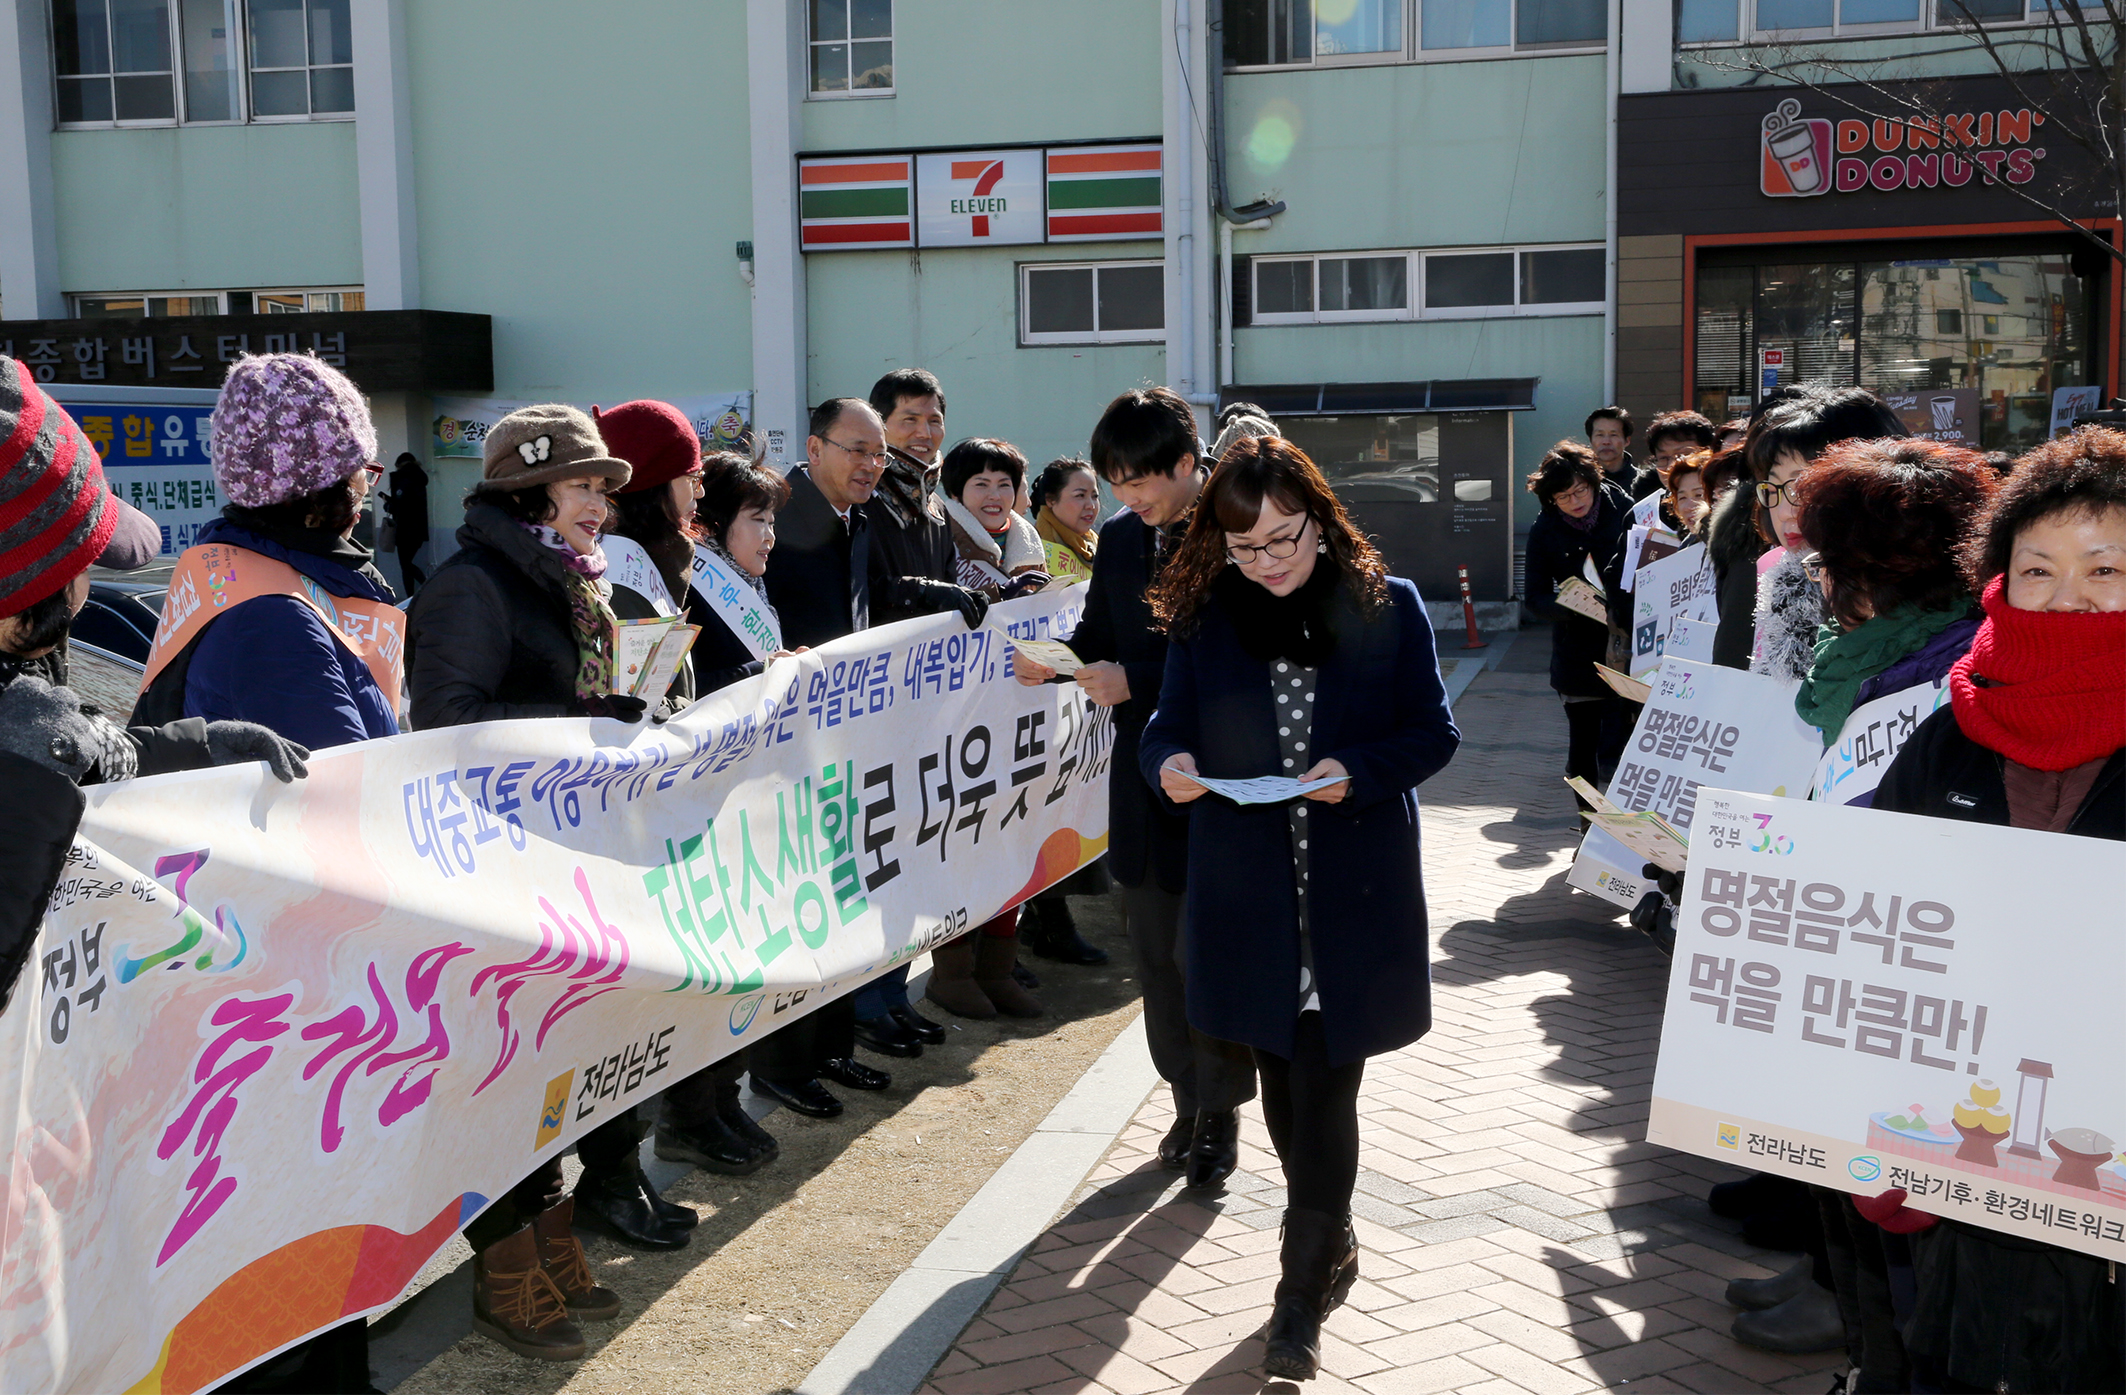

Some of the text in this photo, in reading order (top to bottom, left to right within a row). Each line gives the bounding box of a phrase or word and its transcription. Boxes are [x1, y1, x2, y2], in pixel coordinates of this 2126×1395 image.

[951, 160, 1004, 237] 7
[1836, 149, 2036, 193] DONUTS
[721, 416, 740, 436] 축
[2057, 407, 2074, 420] HOT
[693, 554, 780, 653] 기후·환경
[403, 760, 537, 878] 대중교통
[807, 652, 895, 730] 먹을만큼,
[904, 630, 996, 700] 내복입기,
[1637, 707, 1740, 774] 명절음식은
[916, 725, 997, 863] 더욱
[1616, 762, 1661, 813] 먹을
[65, 845, 98, 870] 복한
[1708, 825, 1742, 849] 정부
[49, 876, 156, 913] 한민국을 여는
[1608, 876, 1637, 899] 전라남도
[1700, 867, 1956, 975] 명절음식은
[41, 921, 107, 1045] 정부
[1688, 952, 1989, 1076] 먹을 만큼만!
[576, 1025, 677, 1122] 전라남도
[1746, 1131, 1828, 1170] 전라남도
